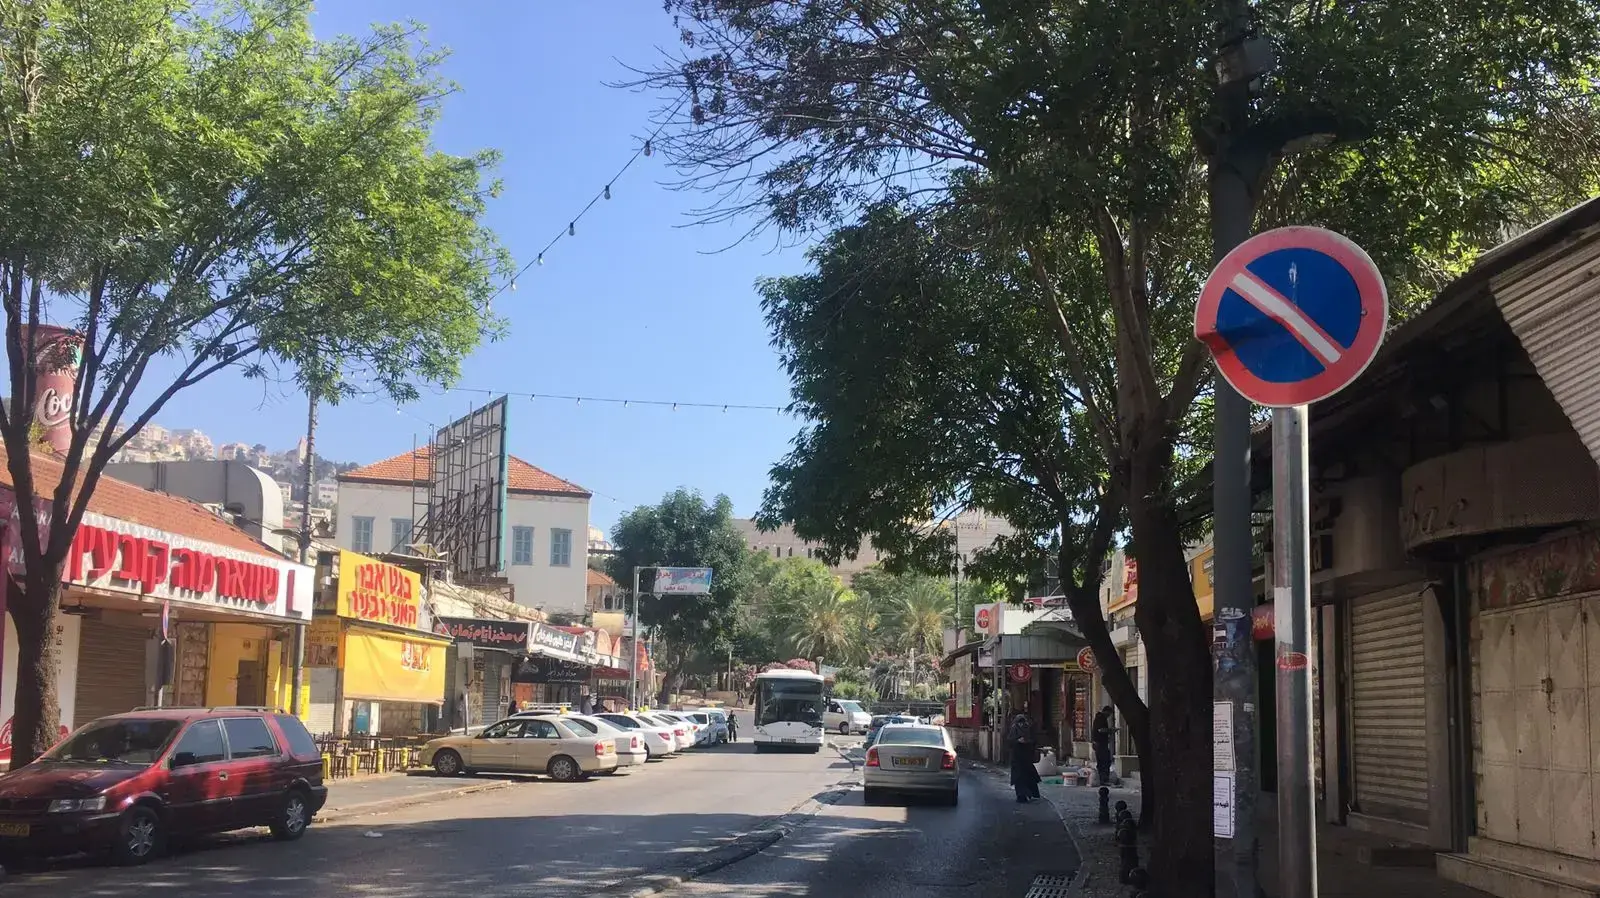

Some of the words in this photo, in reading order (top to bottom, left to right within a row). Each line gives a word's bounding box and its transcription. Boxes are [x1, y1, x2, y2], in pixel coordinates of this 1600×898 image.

[170, 547, 281, 605] שווארמה
[359, 563, 386, 593] אבו
[389, 566, 412, 600] בגט
